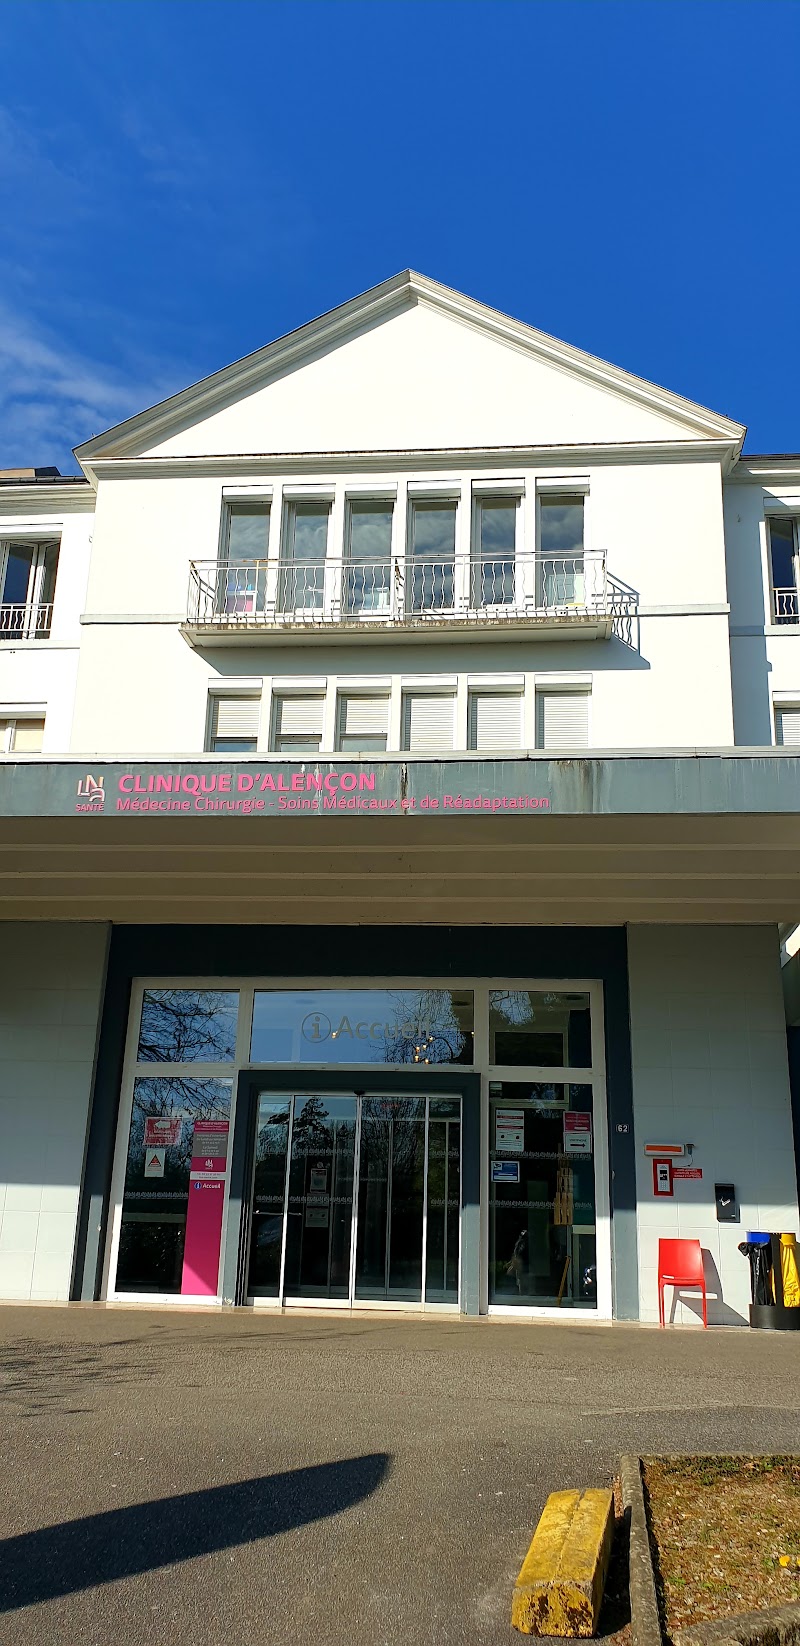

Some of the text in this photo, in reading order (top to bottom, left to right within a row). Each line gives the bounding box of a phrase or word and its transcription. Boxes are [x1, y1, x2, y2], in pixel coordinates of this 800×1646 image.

[118, 772, 376, 797] CLINIQUE D'ALENÇON
[116, 797, 192, 811] Médecine
[195, 796, 265, 814] Chirurgie
[277, 796, 319, 810] Soins
[323, 795, 398, 810] Médicaux
[400, 797, 417, 809] et
[420, 795, 439, 809] de
[443, 794, 550, 812] Réadaptation
[338, 1015, 431, 1040] Accueil
[617, 1124, 628, 1133] 62
